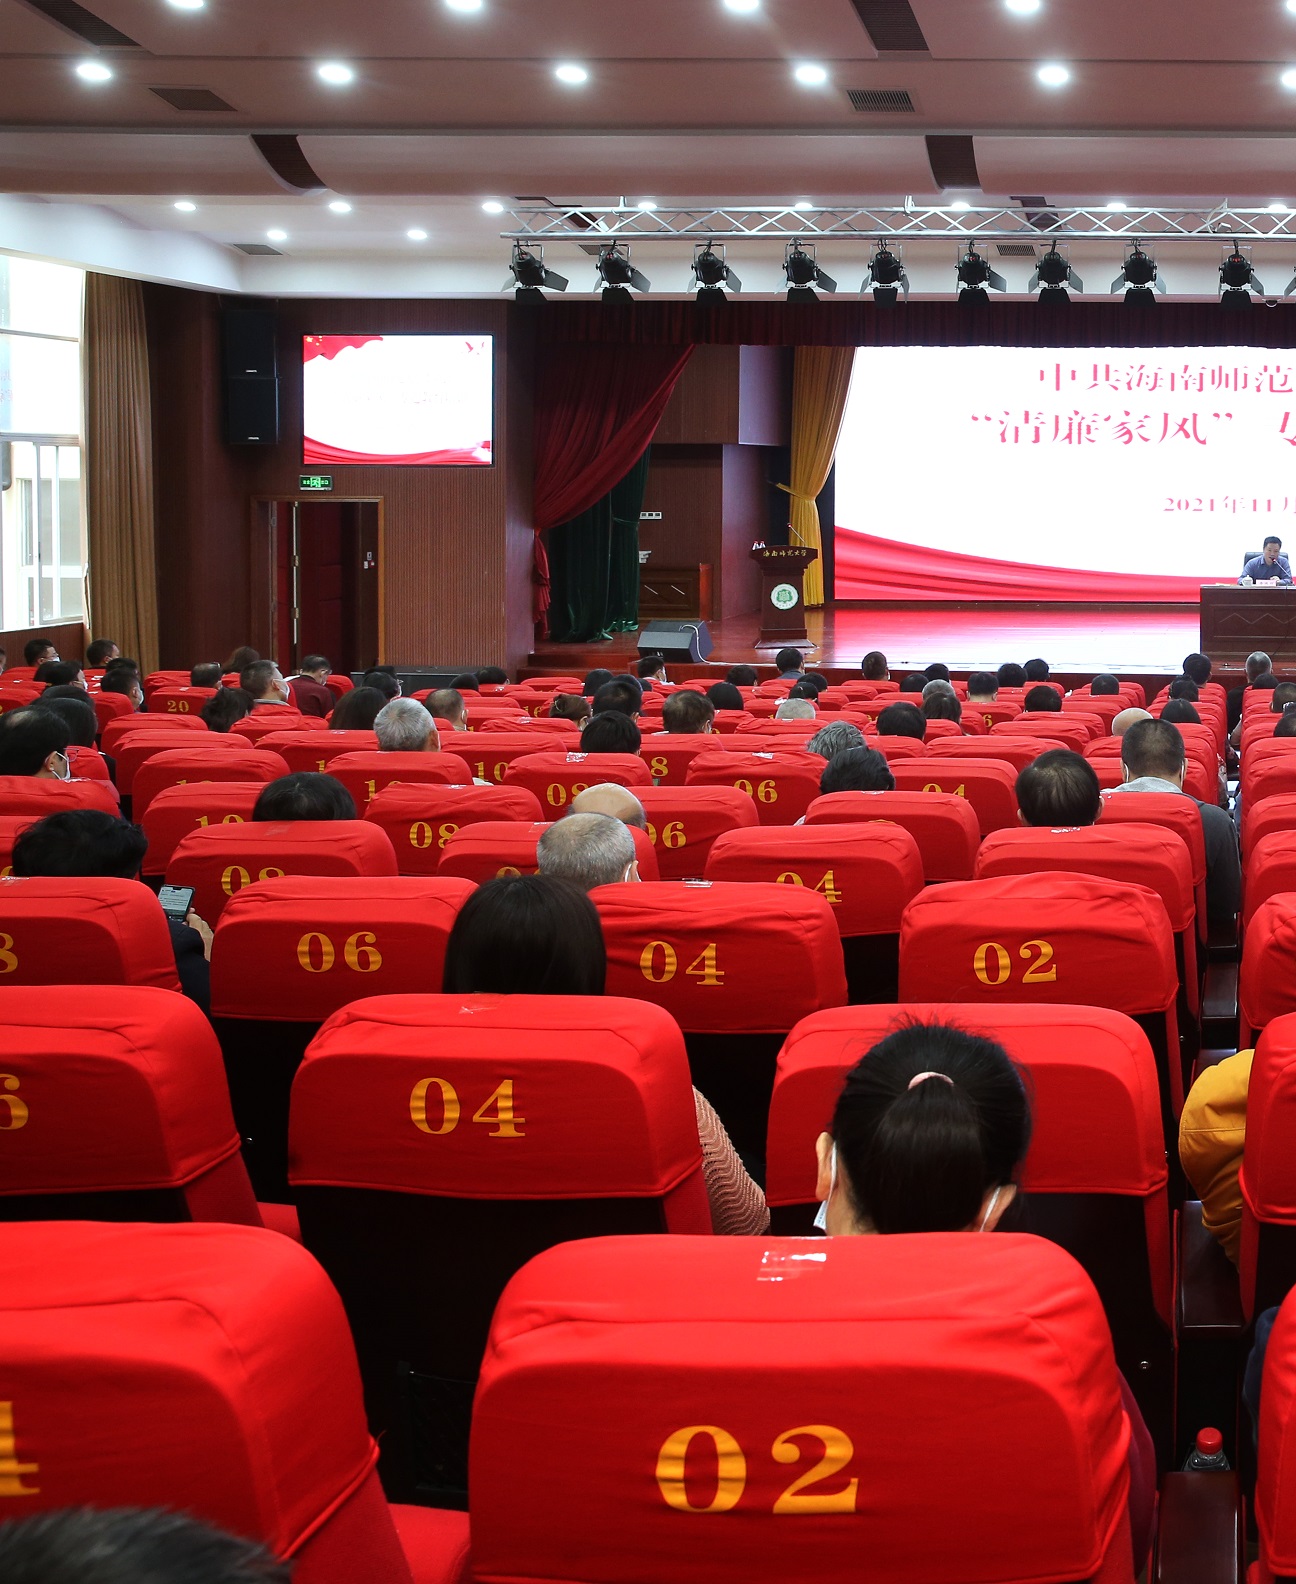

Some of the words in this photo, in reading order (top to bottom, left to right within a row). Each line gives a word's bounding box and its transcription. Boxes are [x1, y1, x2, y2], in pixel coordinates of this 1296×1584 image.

[167, 700, 189, 713] 20
[650, 757, 669, 778] 8
[297, 931, 383, 973] 06
[639, 941, 725, 986] 04
[973, 940, 1057, 985] 02
[409, 1077, 526, 1138] 04
[655, 1424, 858, 1514] 02
